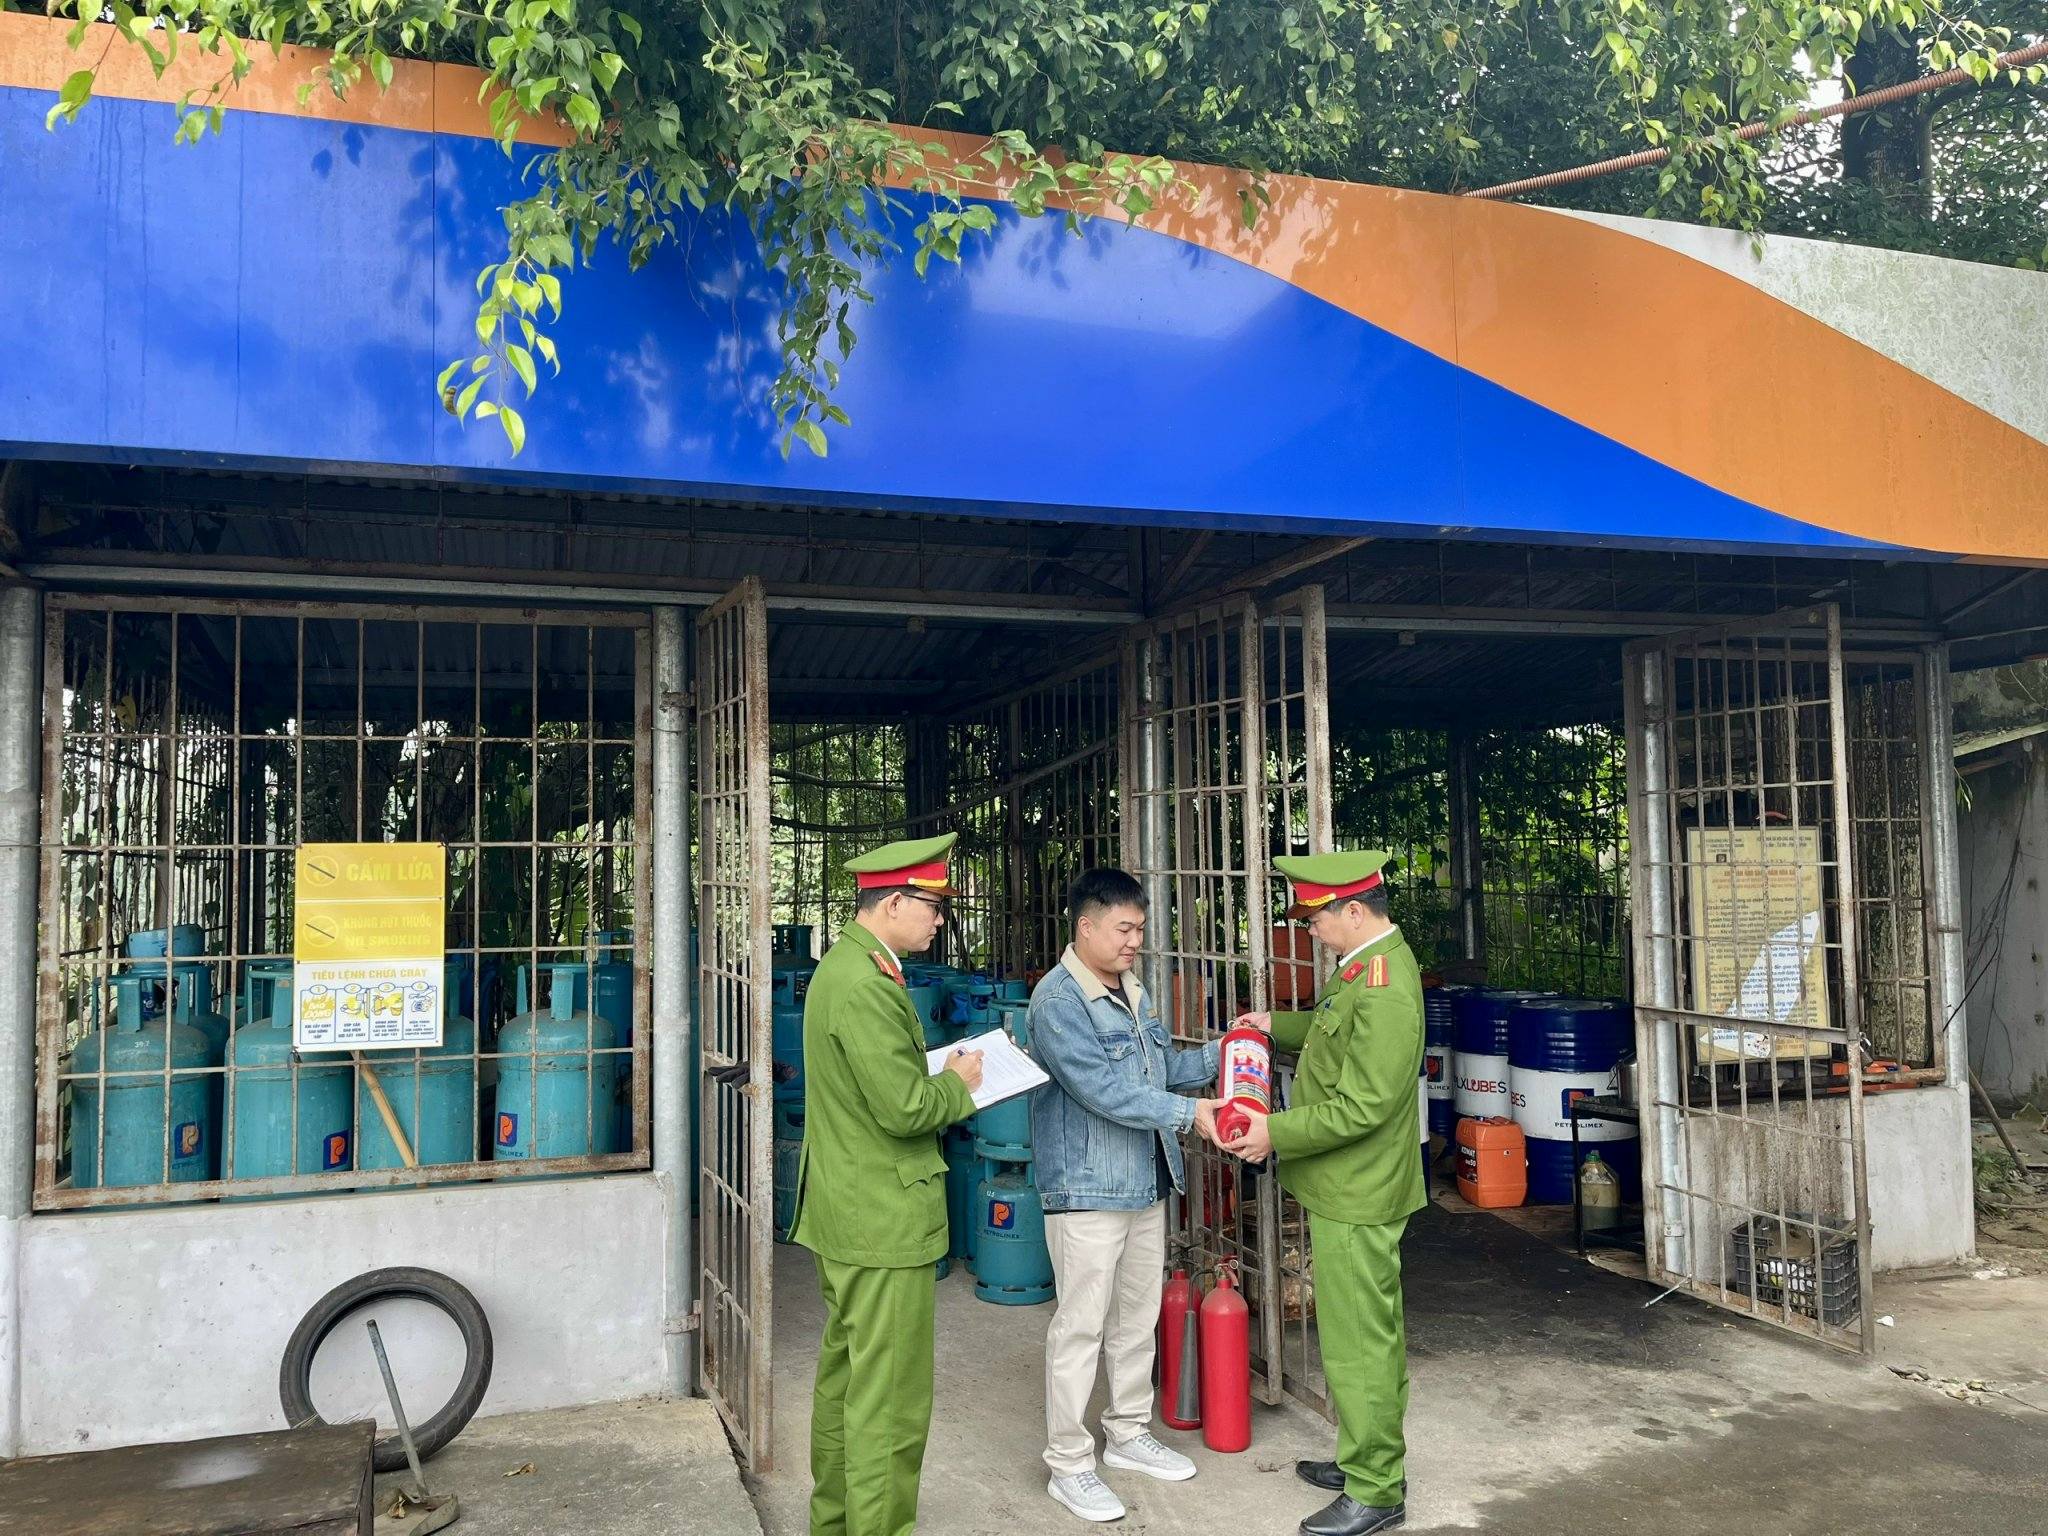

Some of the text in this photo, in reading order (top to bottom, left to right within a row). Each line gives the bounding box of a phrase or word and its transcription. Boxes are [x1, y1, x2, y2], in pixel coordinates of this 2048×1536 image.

[346, 856, 434, 881] CẤM LỬA
[369, 935, 432, 946] SMOKING
